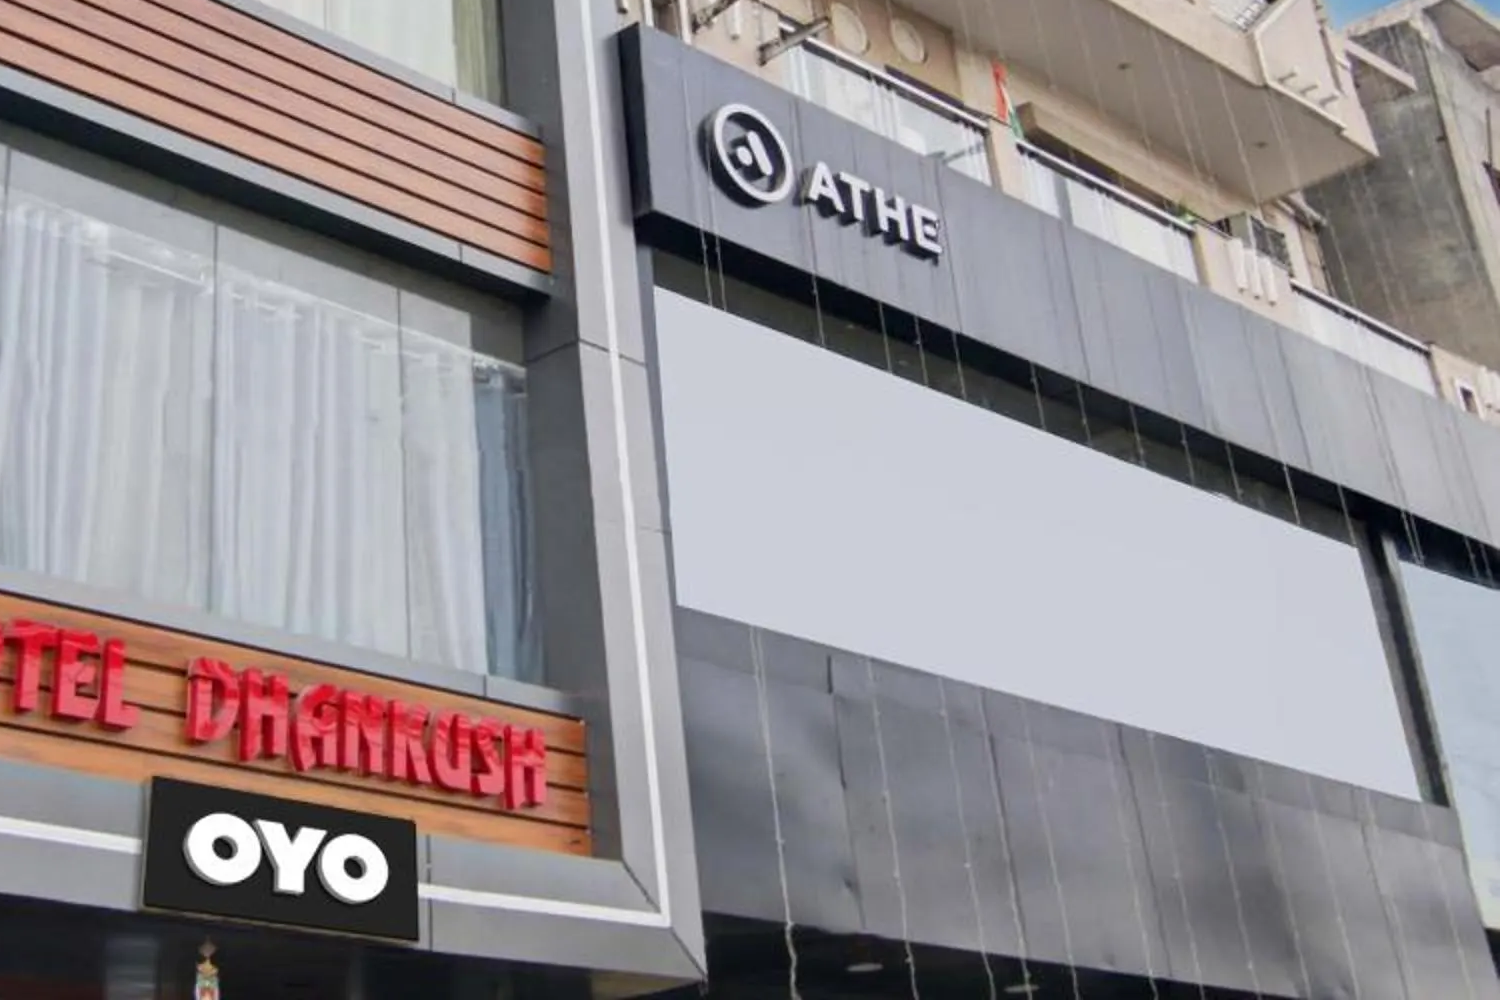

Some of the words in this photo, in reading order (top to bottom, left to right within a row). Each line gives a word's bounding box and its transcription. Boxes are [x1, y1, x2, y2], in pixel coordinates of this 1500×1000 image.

[805, 160, 943, 257] ATHE
[184, 656, 548, 811] DHANKUSH
[183, 811, 389, 905] OYO
